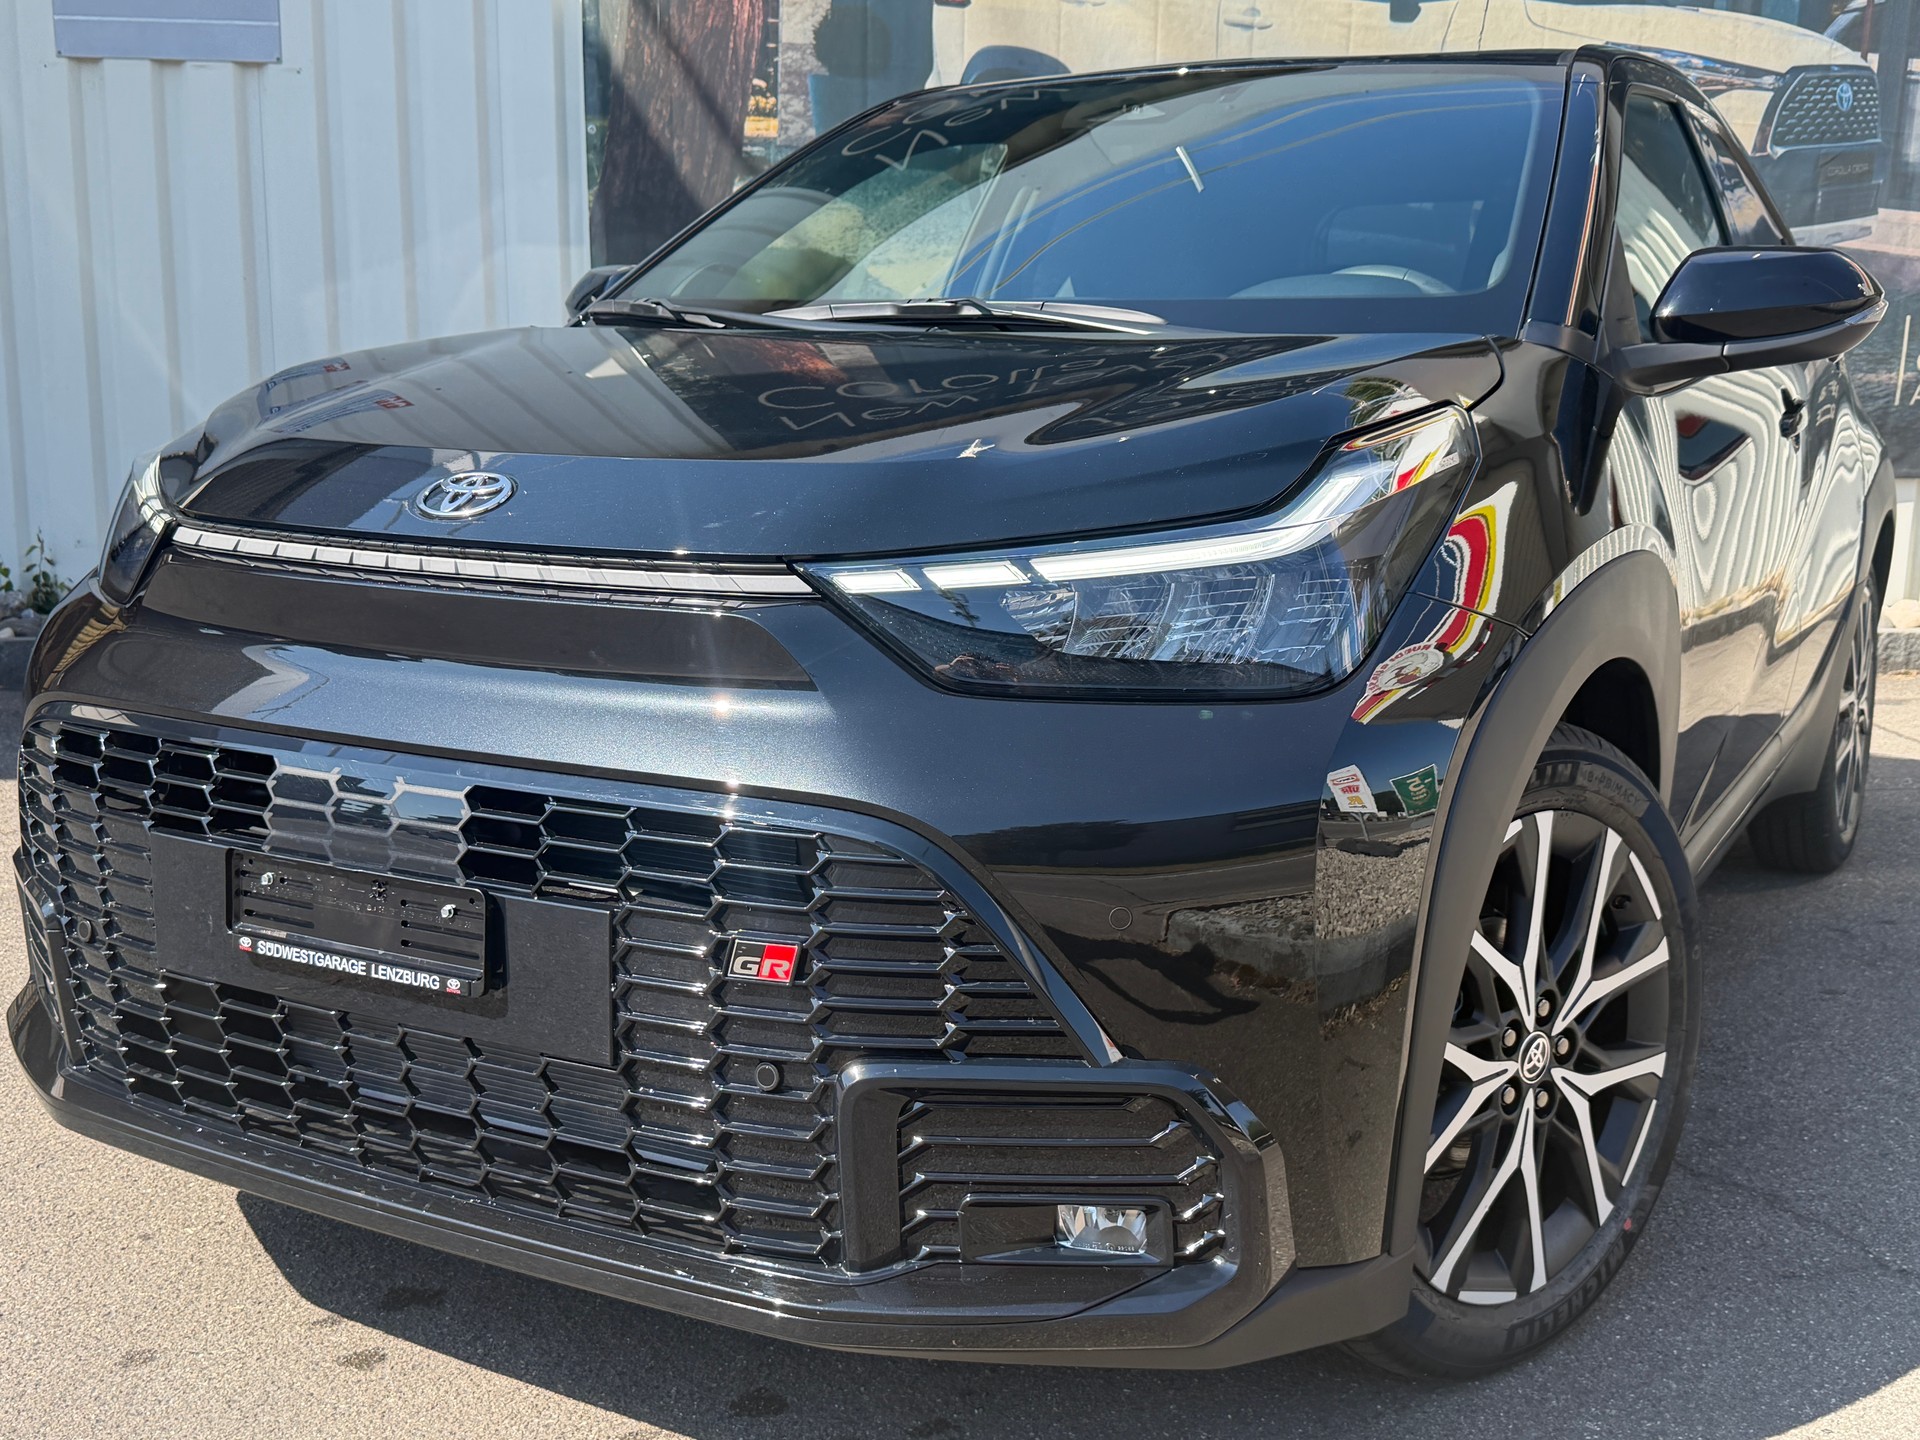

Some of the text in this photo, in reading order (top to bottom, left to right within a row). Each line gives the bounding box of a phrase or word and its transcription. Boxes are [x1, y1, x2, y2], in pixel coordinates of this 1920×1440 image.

[257, 940, 440, 989] SÜDWESTGARAGE LENZBURG
[733, 956, 790, 978] GR
